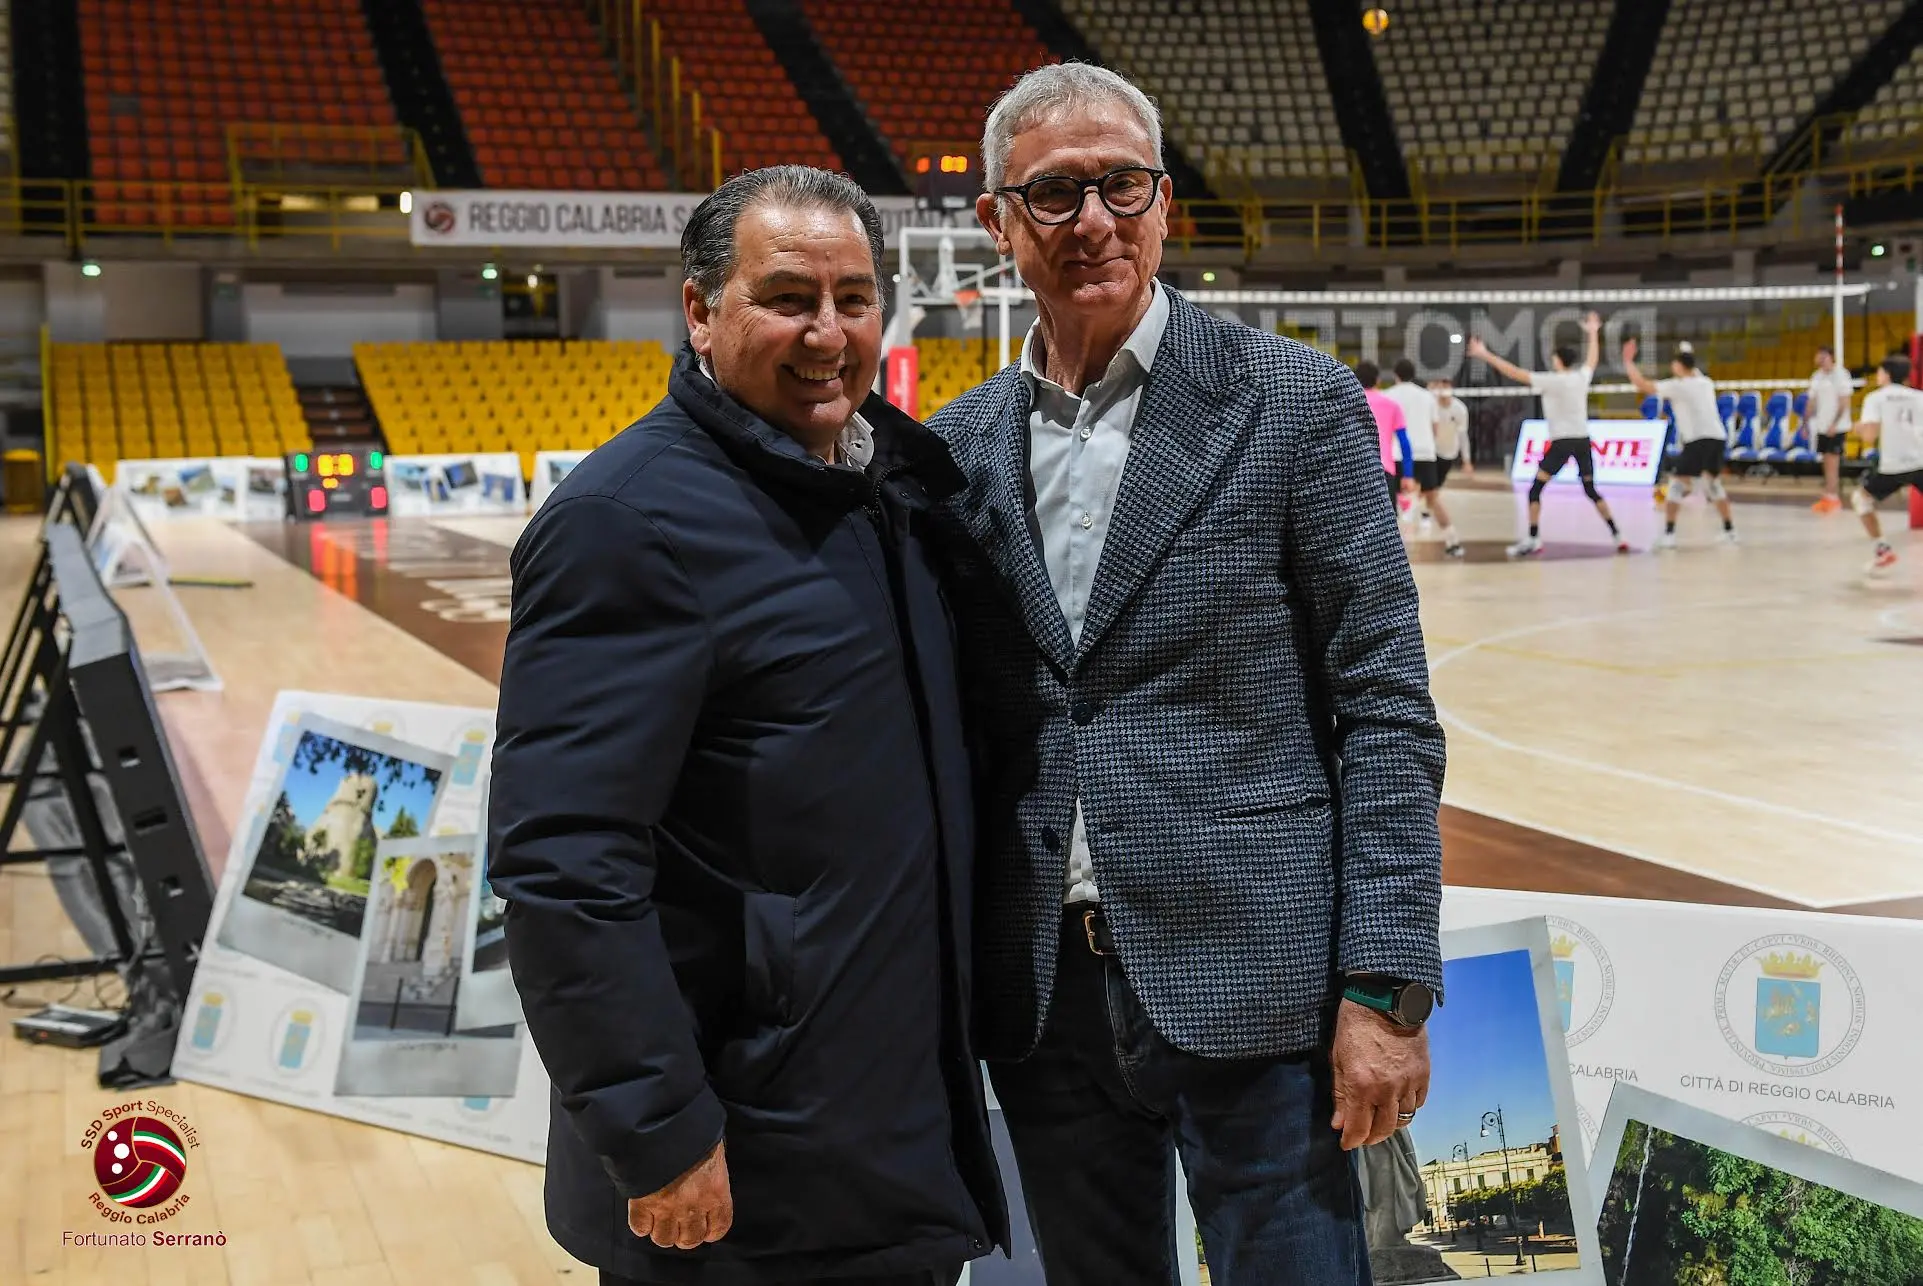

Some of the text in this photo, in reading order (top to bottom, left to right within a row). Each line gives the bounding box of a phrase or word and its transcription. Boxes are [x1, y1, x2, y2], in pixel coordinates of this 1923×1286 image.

[470, 202, 551, 232] REGGIO
[556, 203, 667, 234] CALABRIA
[1680, 1073, 1895, 1109] CITTÀ DI REGGIO CALABRIA
